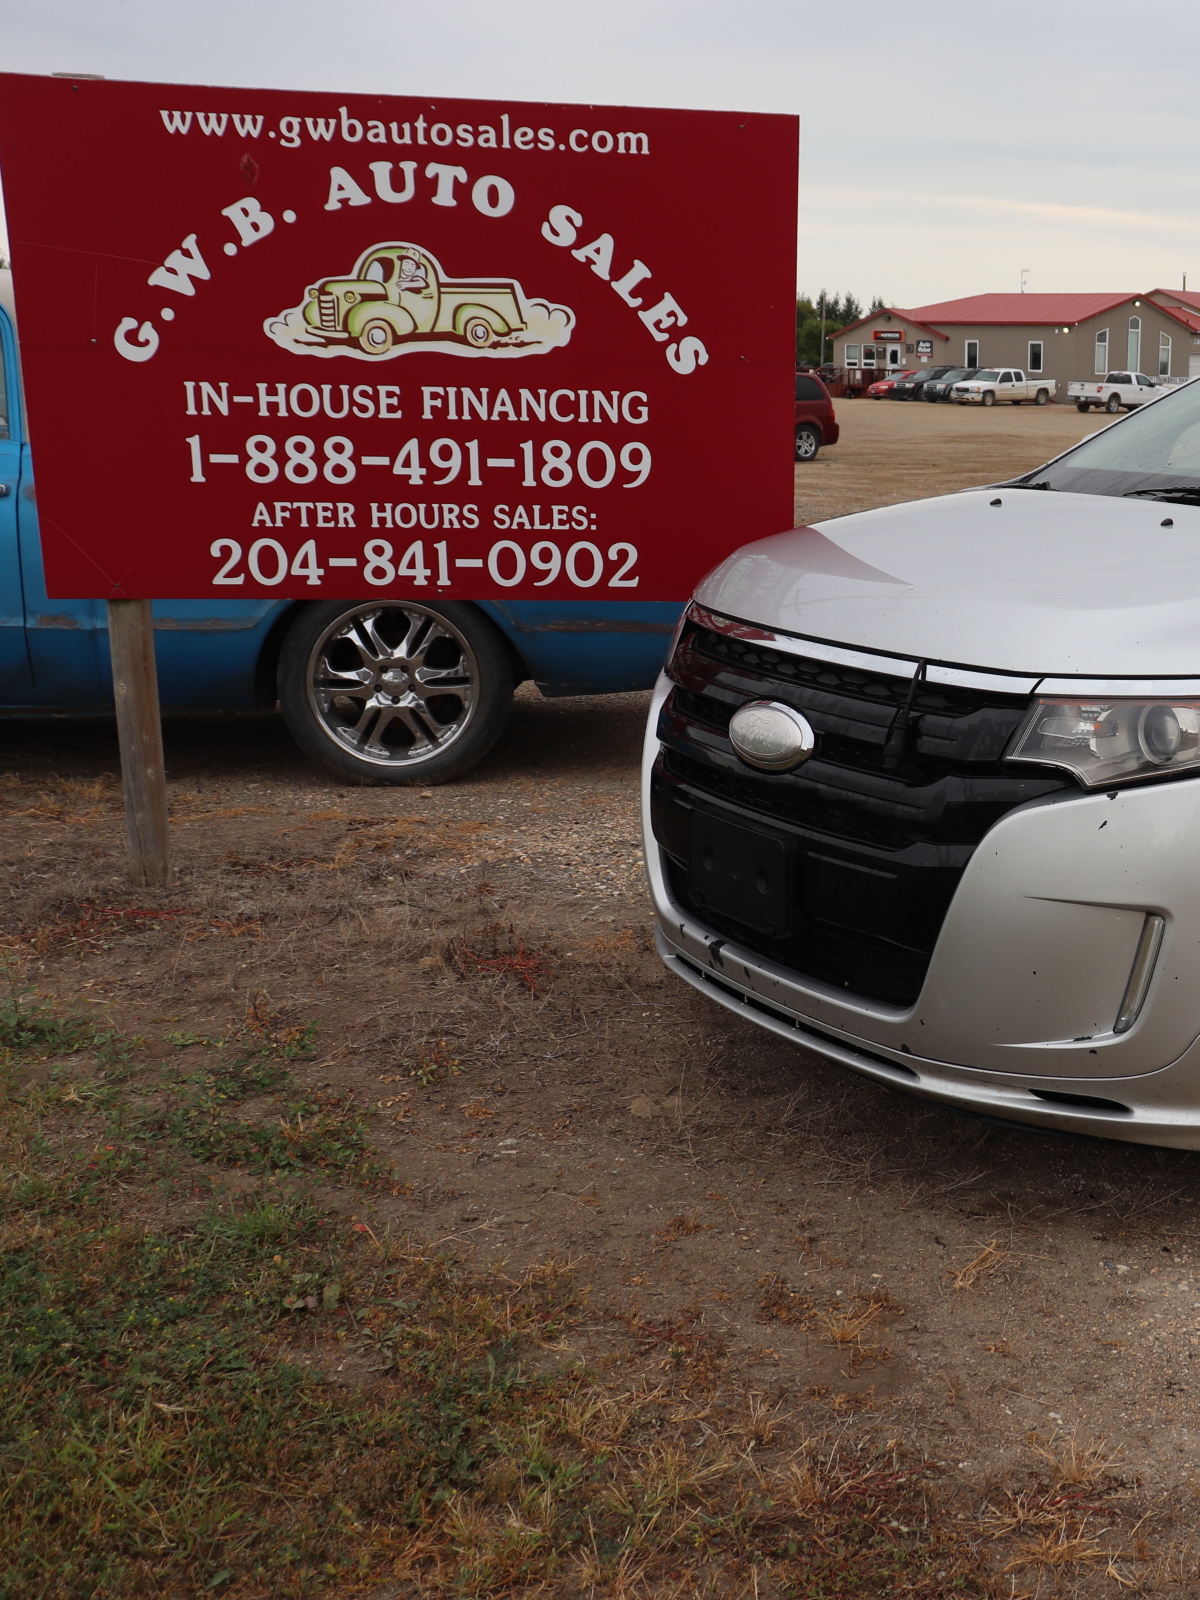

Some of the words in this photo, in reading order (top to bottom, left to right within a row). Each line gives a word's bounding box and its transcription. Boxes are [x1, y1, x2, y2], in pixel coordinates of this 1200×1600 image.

[159, 106, 651, 155] www.gwbautosales.com
[113, 196, 297, 363] G.W.B.
[323, 160, 515, 218] AUTO
[540, 204, 709, 375] SALES
[183, 381, 403, 419] IN-HOUSE
[420, 386, 649, 425] FINANCING
[185, 434, 652, 489] 1-888-491-1809
[251, 501, 357, 529] AFTER
[369, 502, 480, 530] HOURS
[493, 504, 597, 531] SALES:
[209, 537, 640, 588] 204-841-0902
